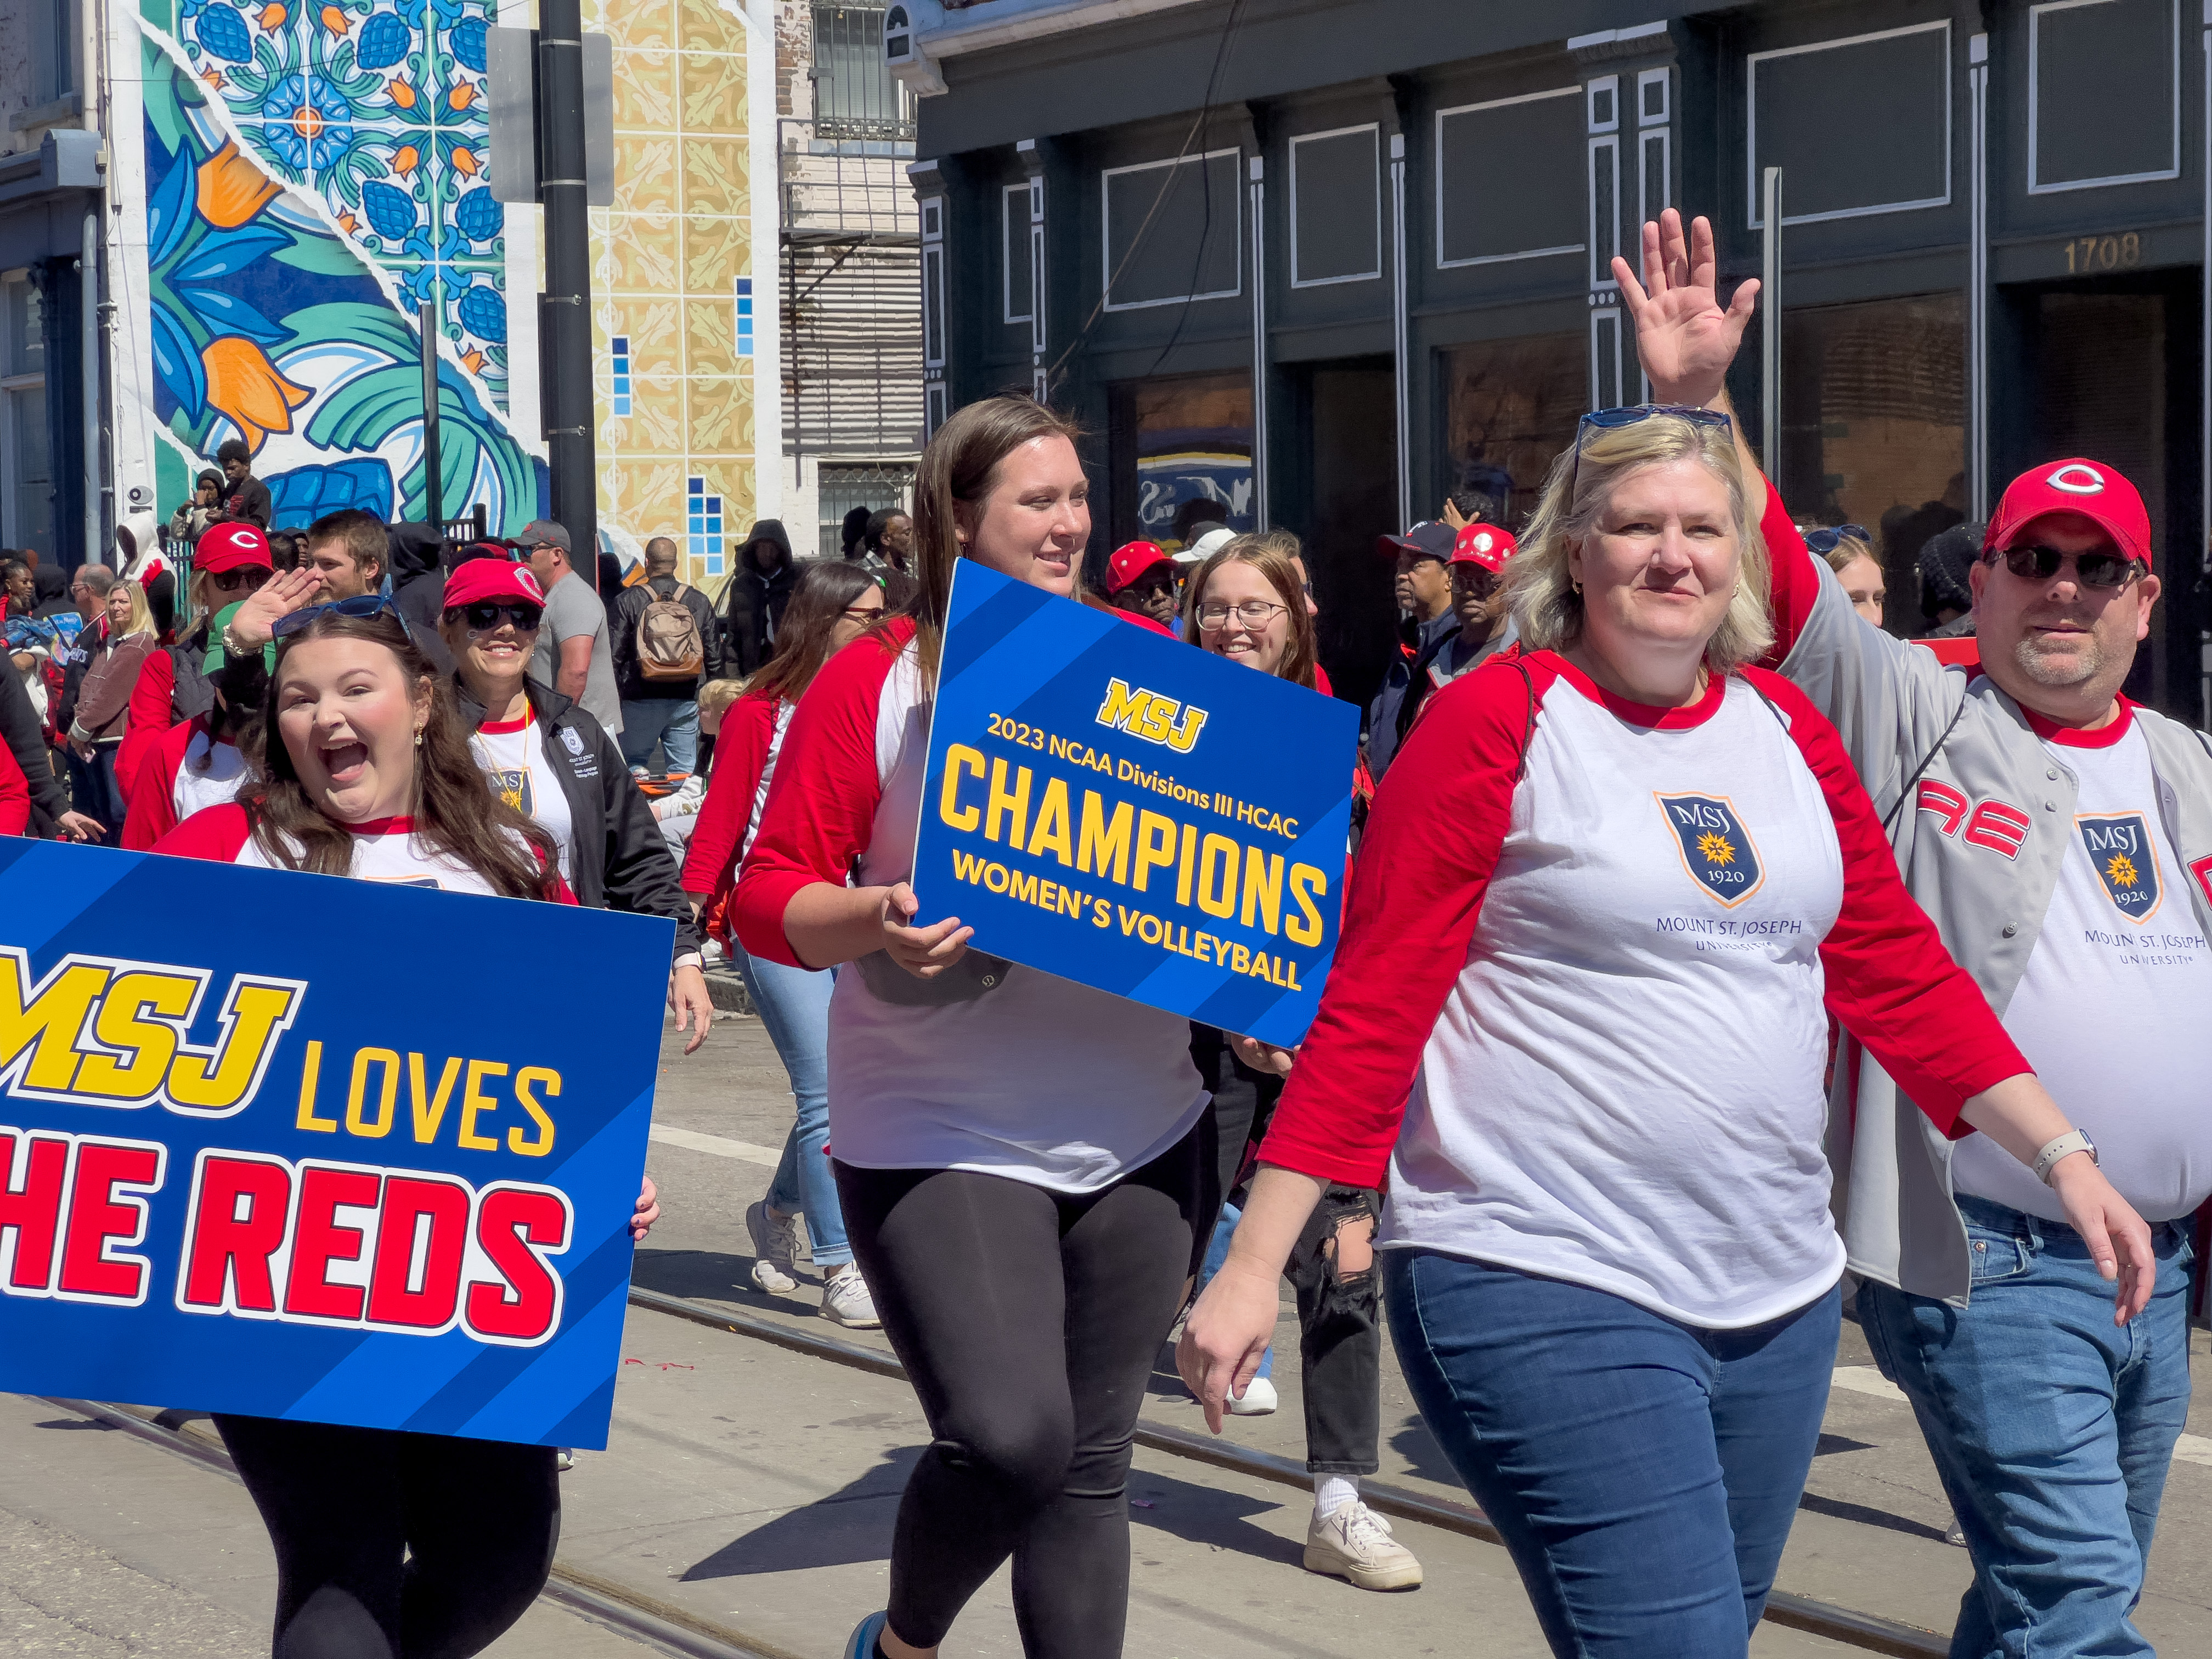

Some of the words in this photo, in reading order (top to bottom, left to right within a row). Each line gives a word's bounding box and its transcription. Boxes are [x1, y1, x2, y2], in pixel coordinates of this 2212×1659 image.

[2065, 232, 2139, 274] 1708
[1096, 677, 1209, 754] MSJ
[987, 713, 1045, 751] 2023
[1049, 734, 1113, 776] NCAA
[1118, 759, 1210, 810] Divisions
[1214, 793, 1233, 817] III
[1237, 802, 1299, 839] HCAC
[1671, 803, 1731, 834] MSJ
[939, 743, 1328, 948] CHAMPIONS
[2085, 824, 2138, 856] MSJ
[1707, 870, 1745, 885] 1920
[2115, 890, 2148, 906] 1920
[952, 849, 1111, 928] WOMEN'S
[1119, 905, 1302, 991] VOLLEYBALL
[1656, 917, 1714, 934] MOUNT
[1718, 921, 1737, 935] ST.
[1740, 919, 1802, 938] JOSEPH
[2140, 935, 2159, 948] ST.
[2162, 934, 2207, 950] JOSEPH
[0, 946, 308, 1118] MSJ
[296, 1040, 561, 1157] LOVES
[175, 1147, 574, 1348] REDS
